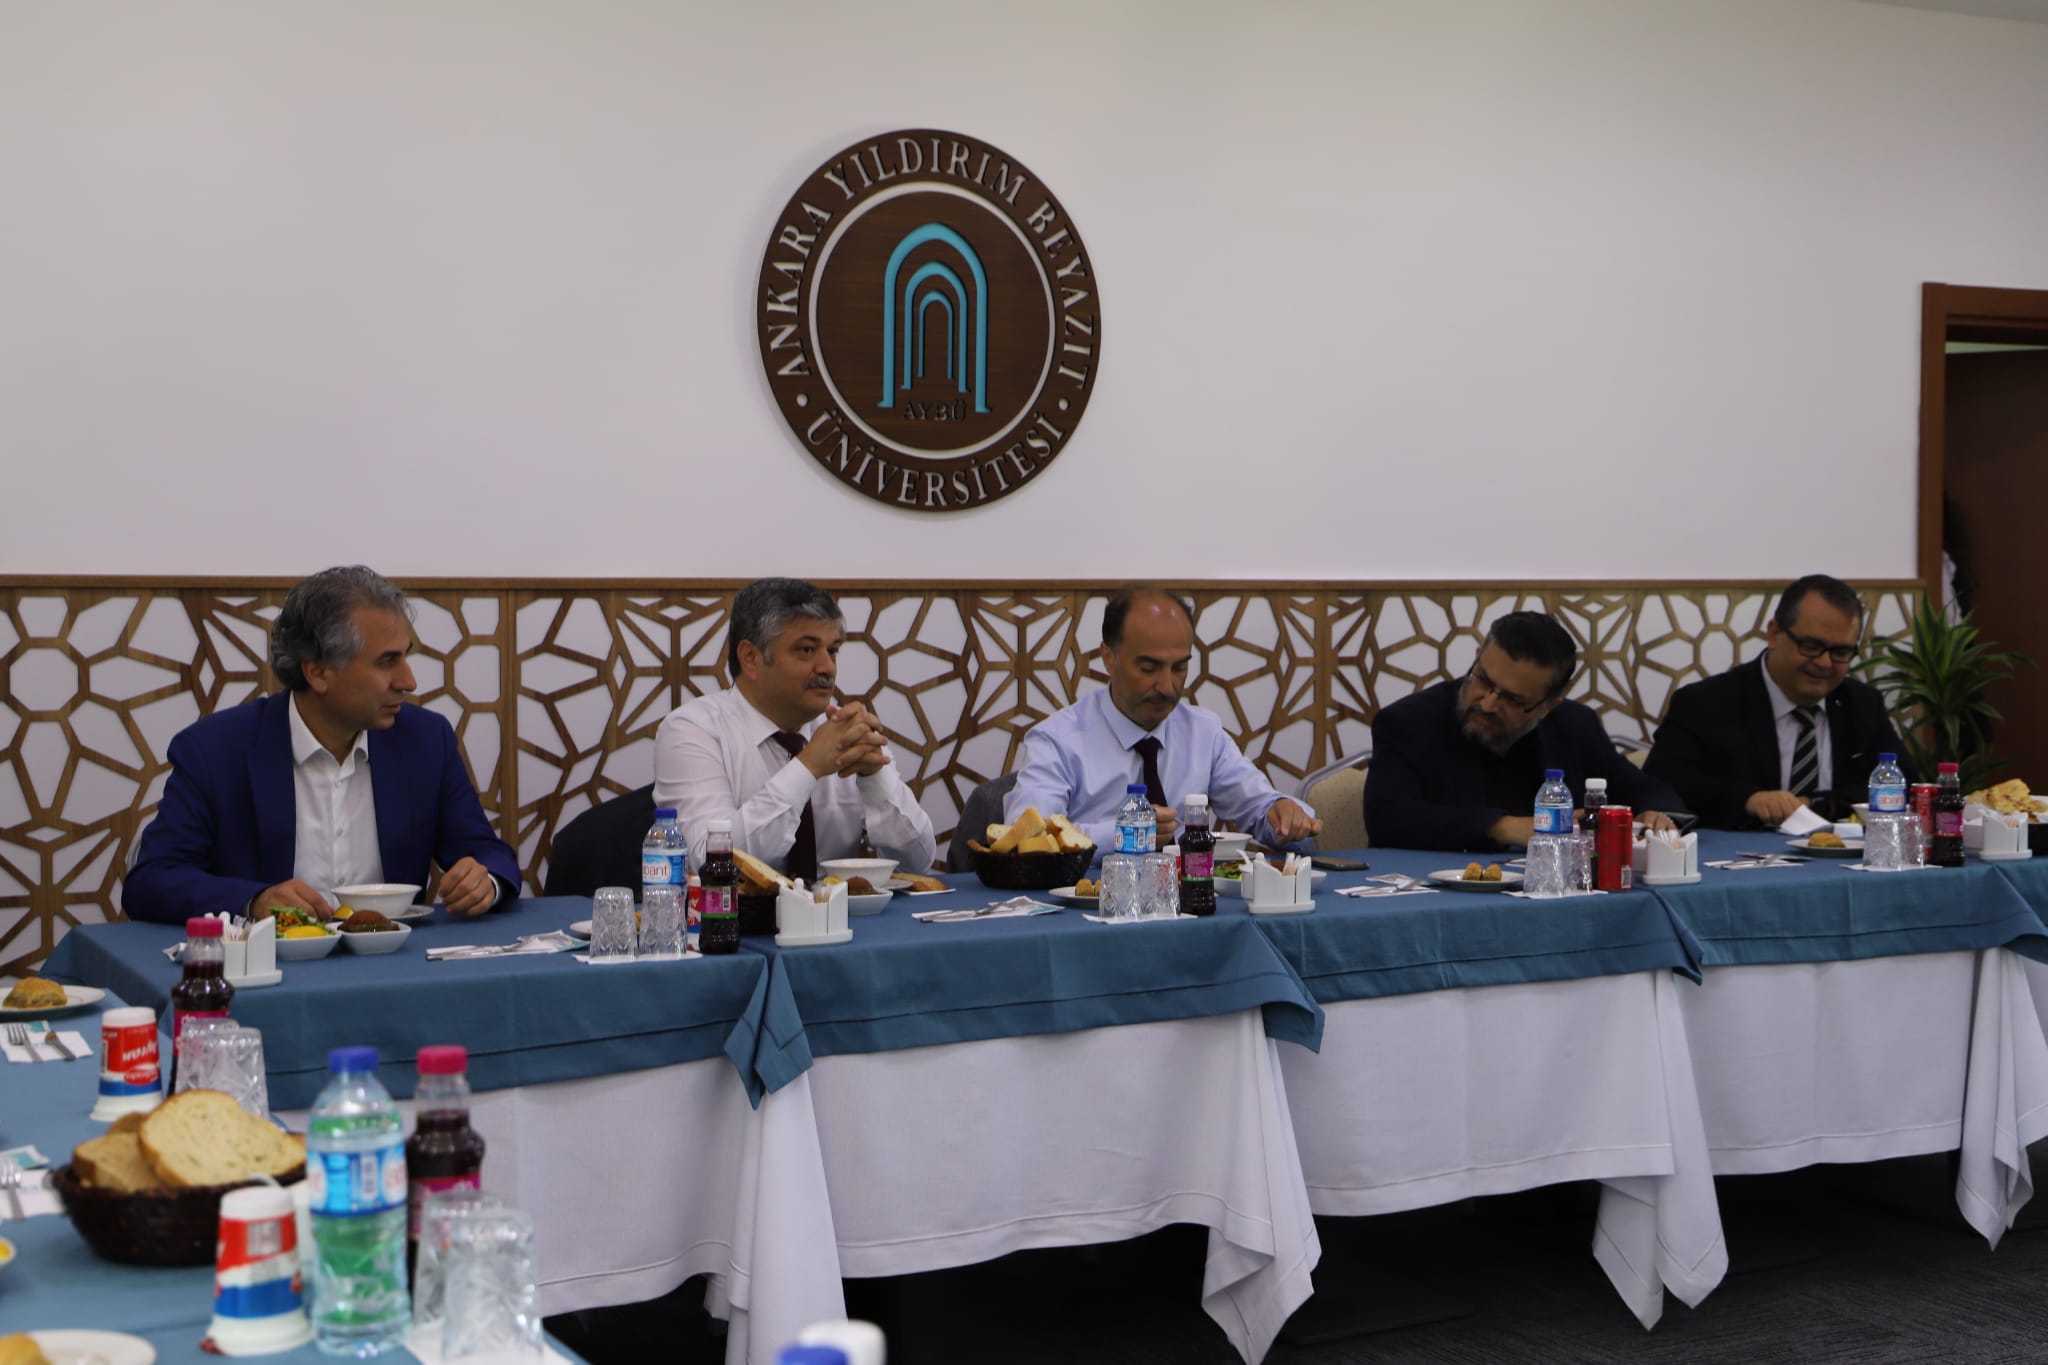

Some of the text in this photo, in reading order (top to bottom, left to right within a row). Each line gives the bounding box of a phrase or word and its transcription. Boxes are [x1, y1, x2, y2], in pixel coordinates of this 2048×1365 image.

[767, 137, 1094, 391] ANKARA YILDIRIM BEYAZIT
[903, 400, 968, 422] AYBÜ
[806, 408, 1065, 507] ÜNİVERSİTESİ
[643, 864, 669, 877] bant
